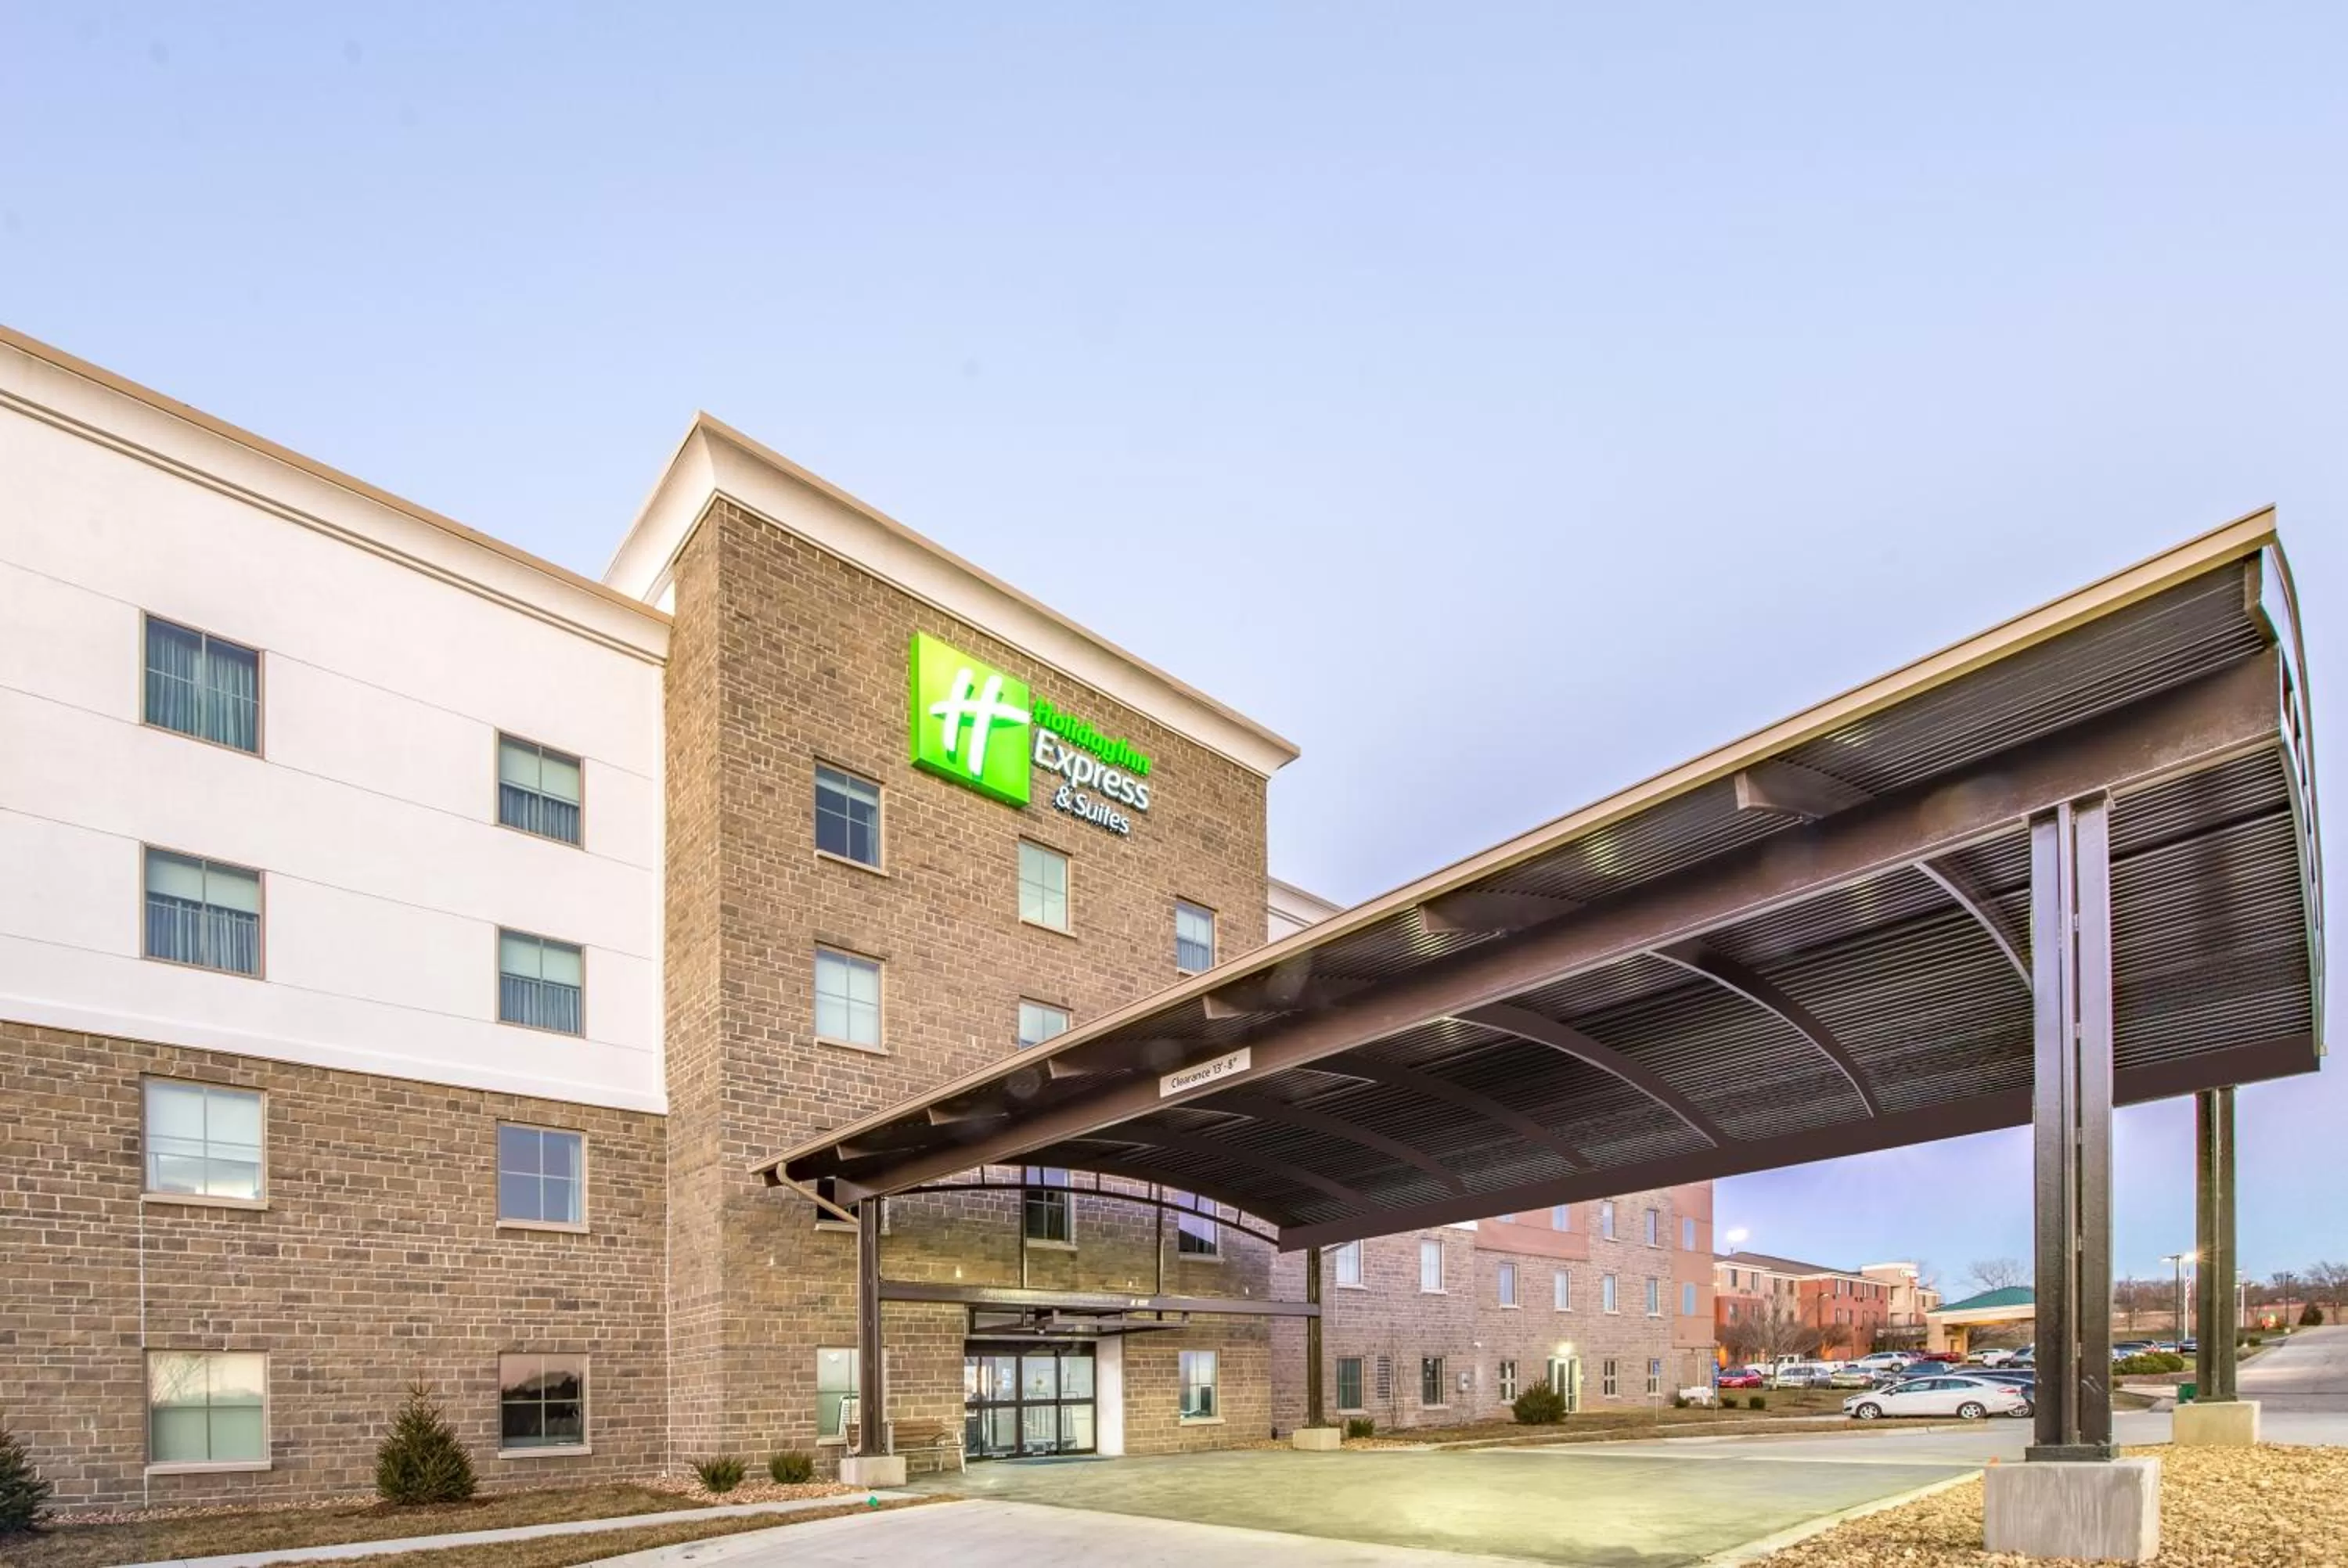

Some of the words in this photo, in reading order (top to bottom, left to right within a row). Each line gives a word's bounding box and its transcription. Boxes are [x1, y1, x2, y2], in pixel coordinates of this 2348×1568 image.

[1033, 728, 1150, 811] Express
[1053, 784, 1071, 811] &
[1072, 793, 1129, 835] Suites
[1170, 1069, 1211, 1088] Clearance
